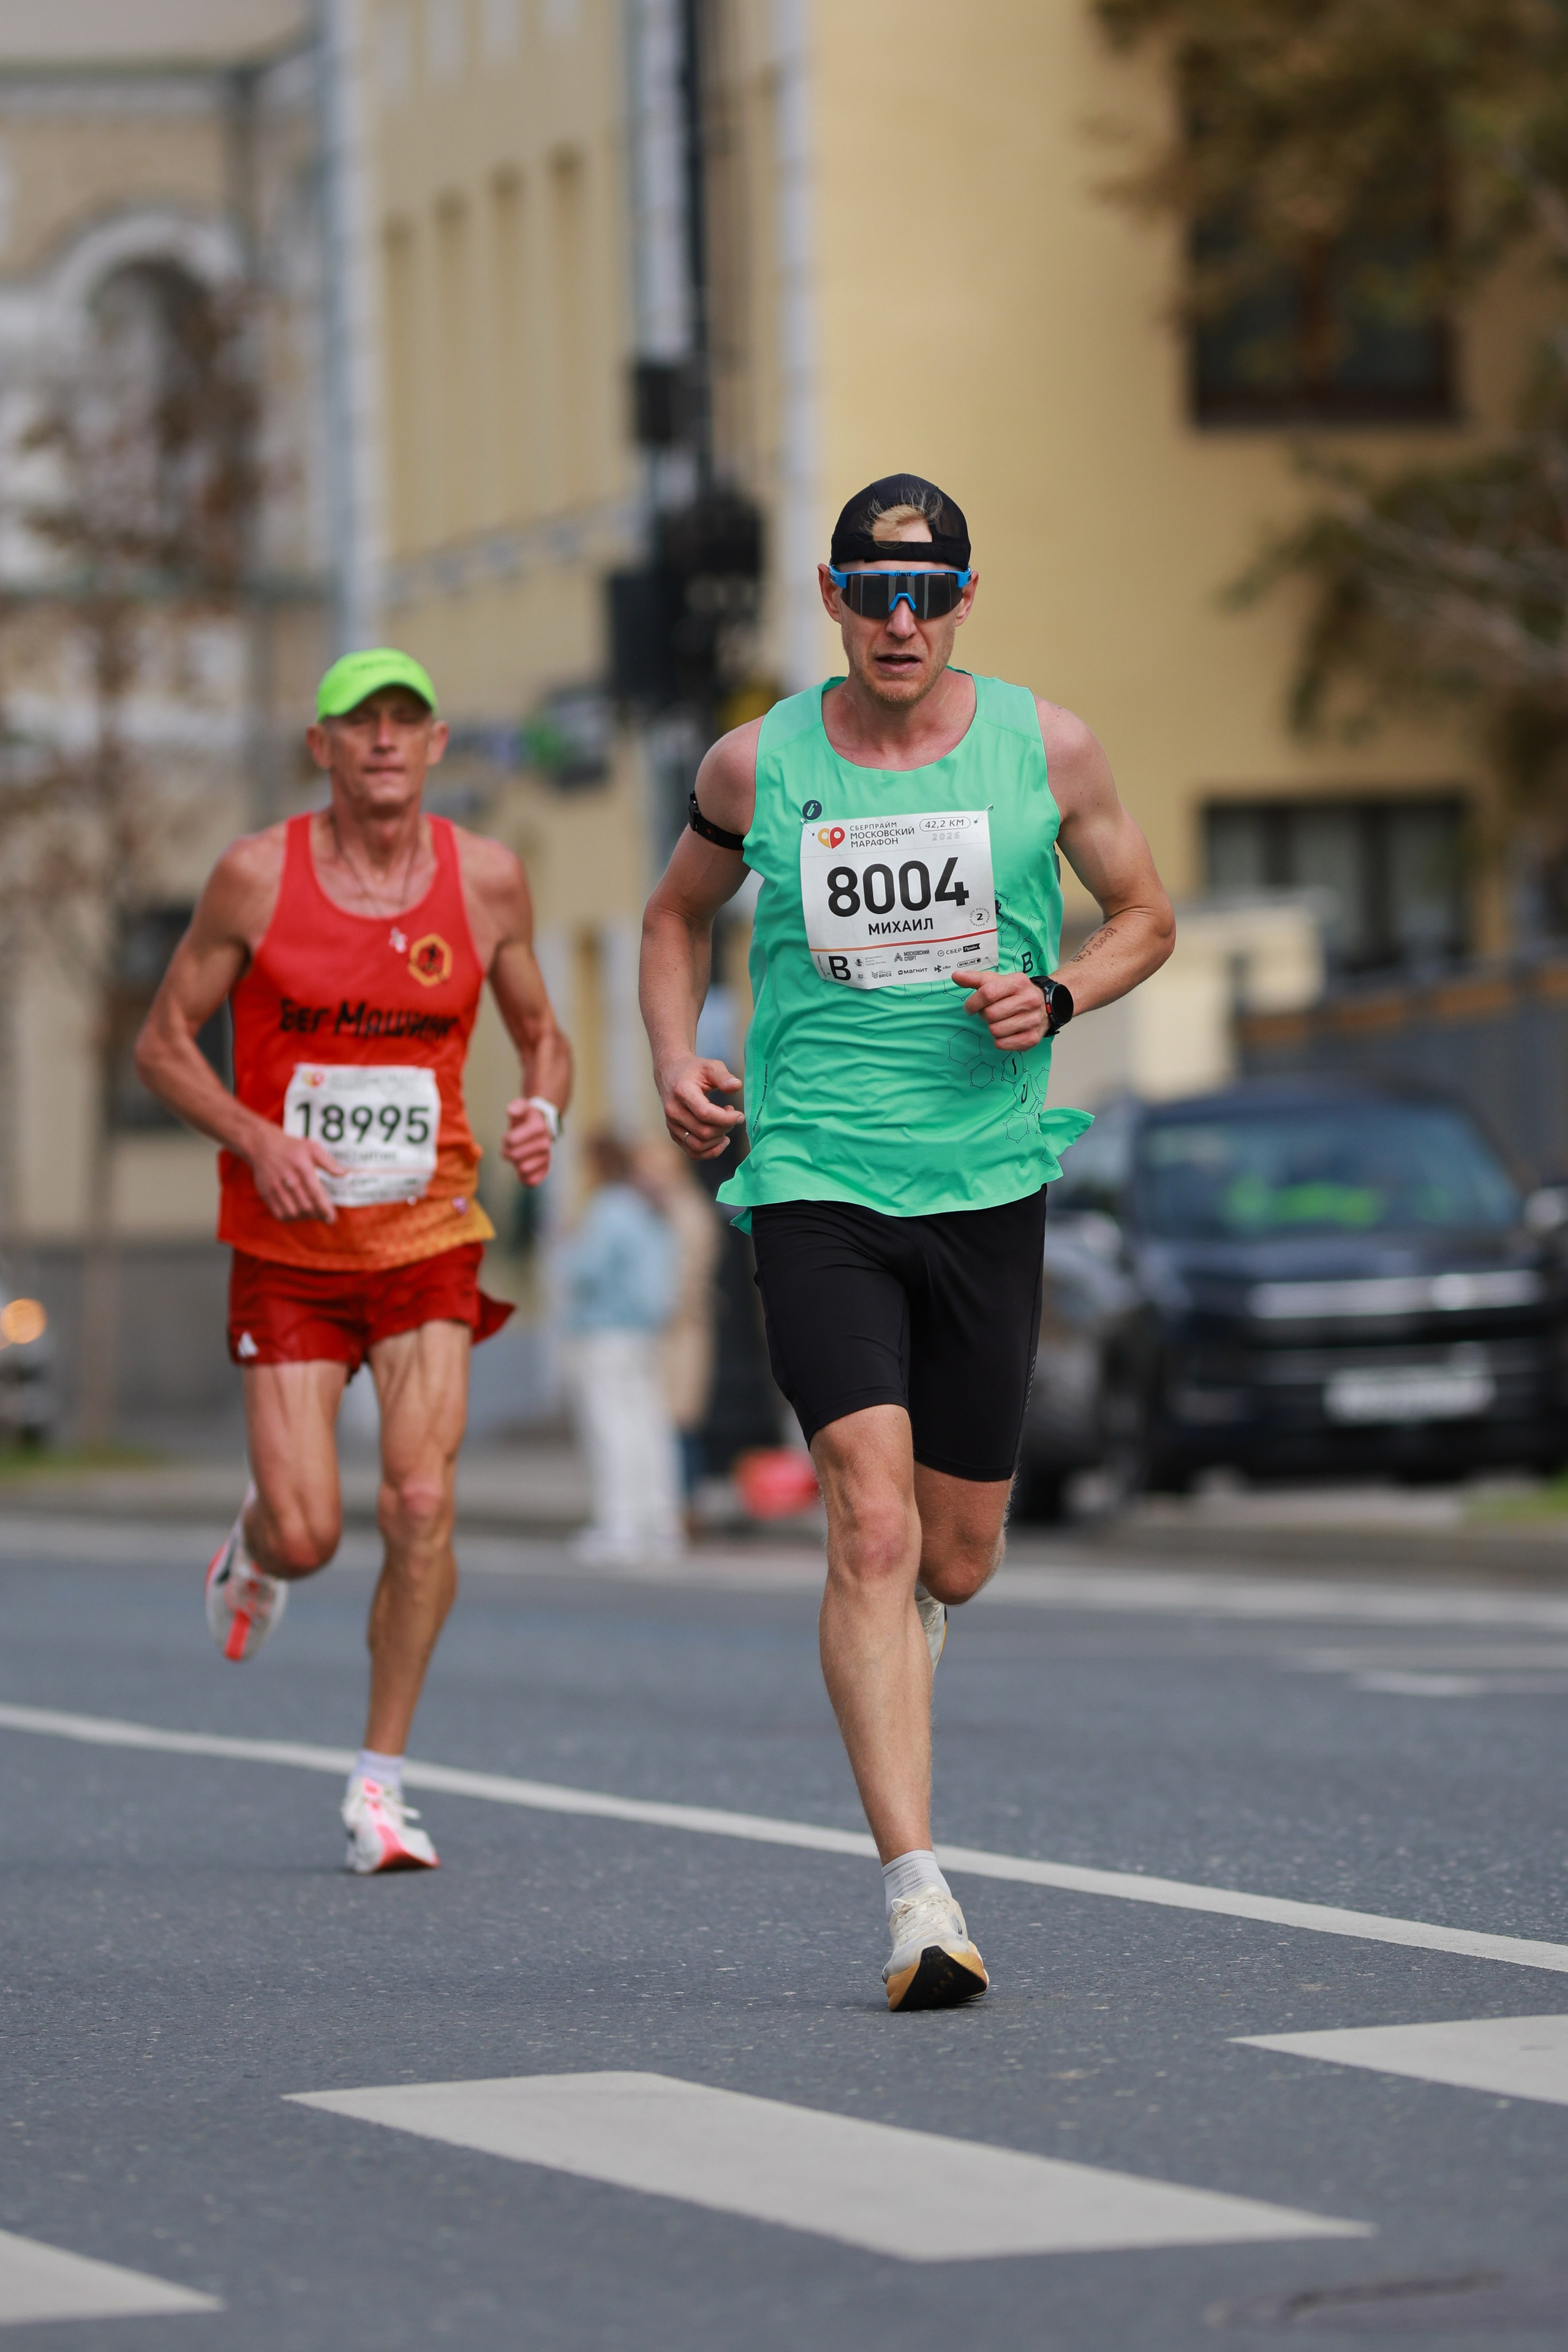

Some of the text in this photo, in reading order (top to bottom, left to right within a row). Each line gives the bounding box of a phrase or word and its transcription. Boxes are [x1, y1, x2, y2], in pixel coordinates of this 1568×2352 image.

[850, 822, 897, 831] СБЕРПРАЙМ
[925, 820, 945, 829] 42,2
[850, 826, 914, 839] МОСКОВСКИЙ
[932, 832, 960, 841] 2026
[851, 837, 899, 848] МАРАФОН
[827, 857, 970, 918] 8004
[868, 918, 934, 935] МИХАИЛ
[295, 1101, 430, 1145] 18995
